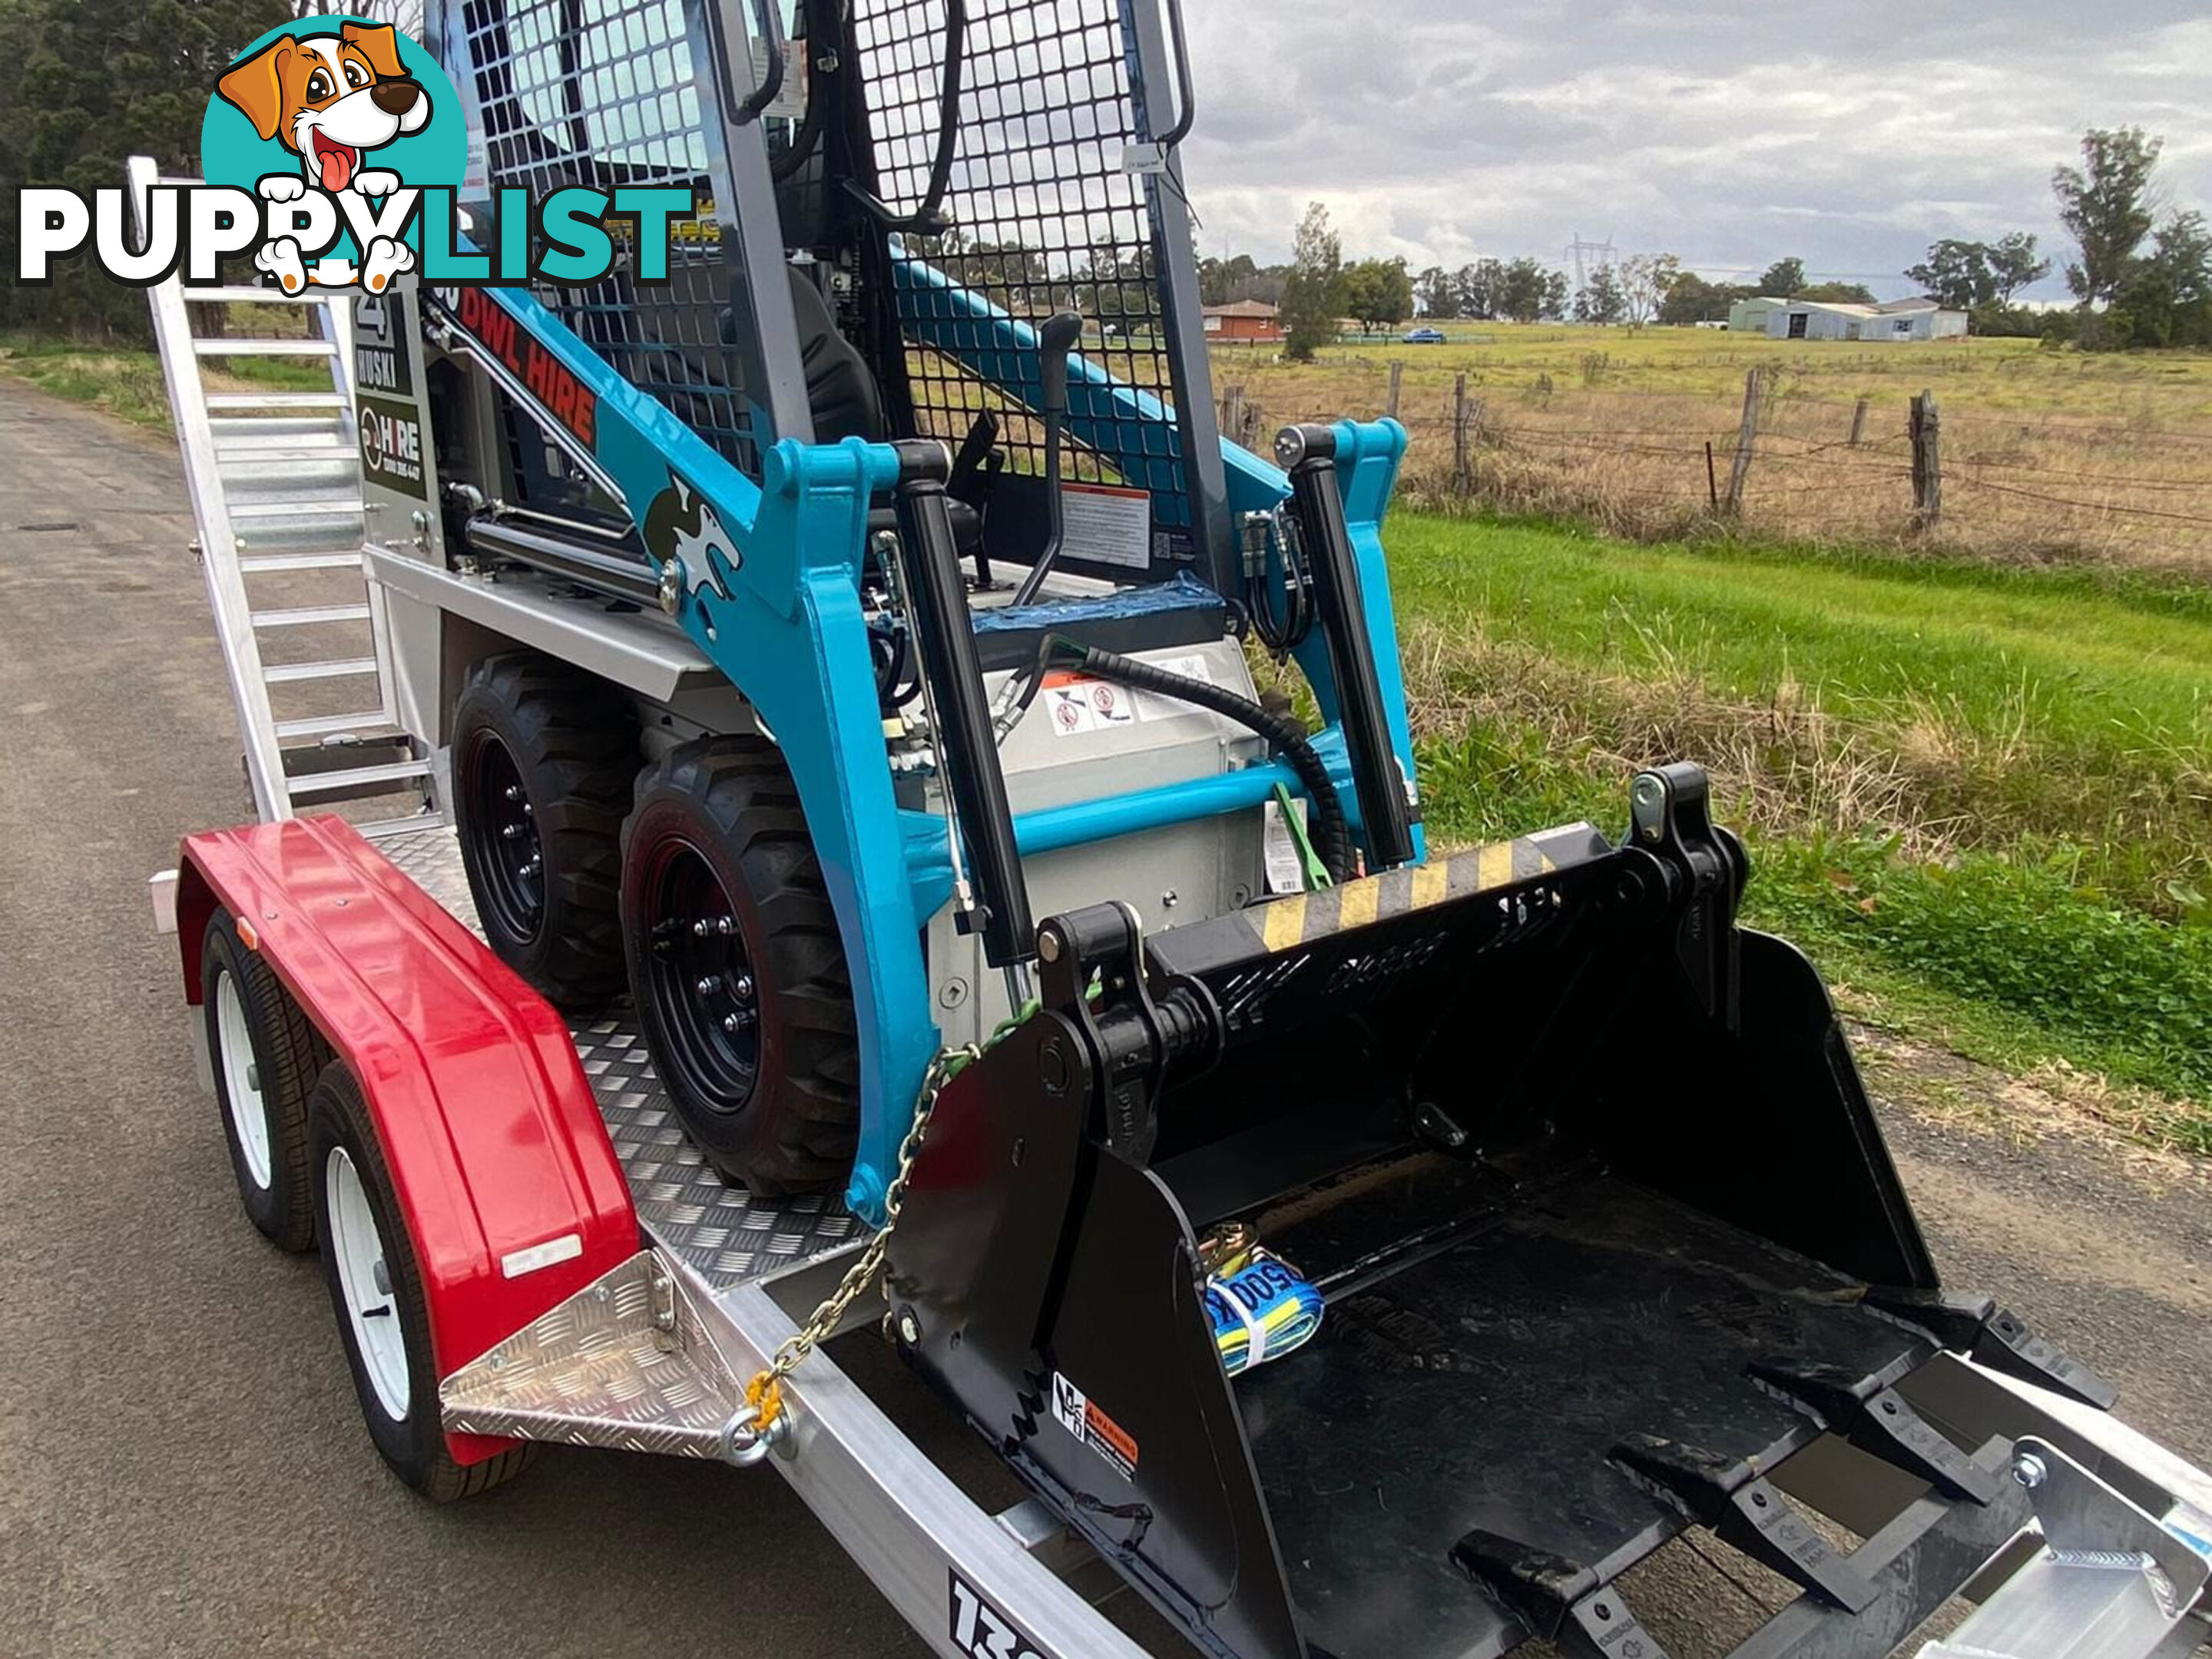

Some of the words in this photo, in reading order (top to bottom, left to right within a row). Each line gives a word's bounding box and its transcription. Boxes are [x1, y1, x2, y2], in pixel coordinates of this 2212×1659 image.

[462, 287, 522, 374] DWL
[526, 339, 595, 445] HIRE
[379, 416, 420, 461] HIRE
